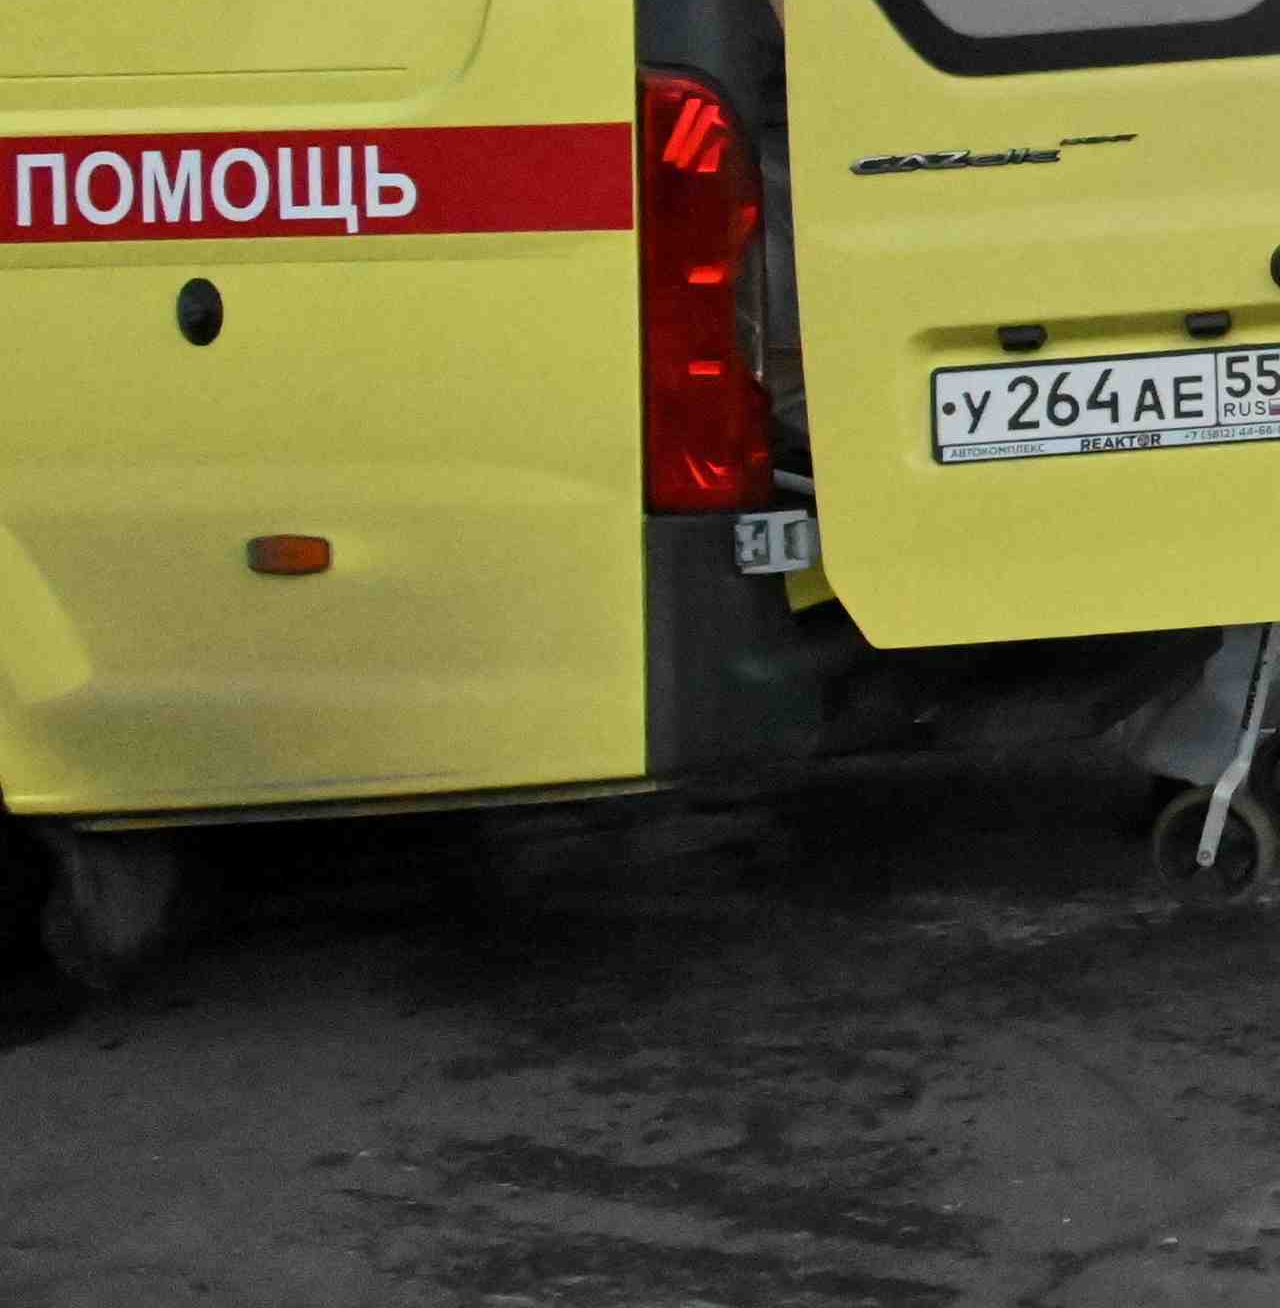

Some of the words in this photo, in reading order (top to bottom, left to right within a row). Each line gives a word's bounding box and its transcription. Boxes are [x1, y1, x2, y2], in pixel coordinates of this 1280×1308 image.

[15, 145, 417, 233] ПОМОЩЬ
[1224, 401, 1266, 417] RUS
[950, 443, 1045, 460] АВТОКОМПЛЕКС
